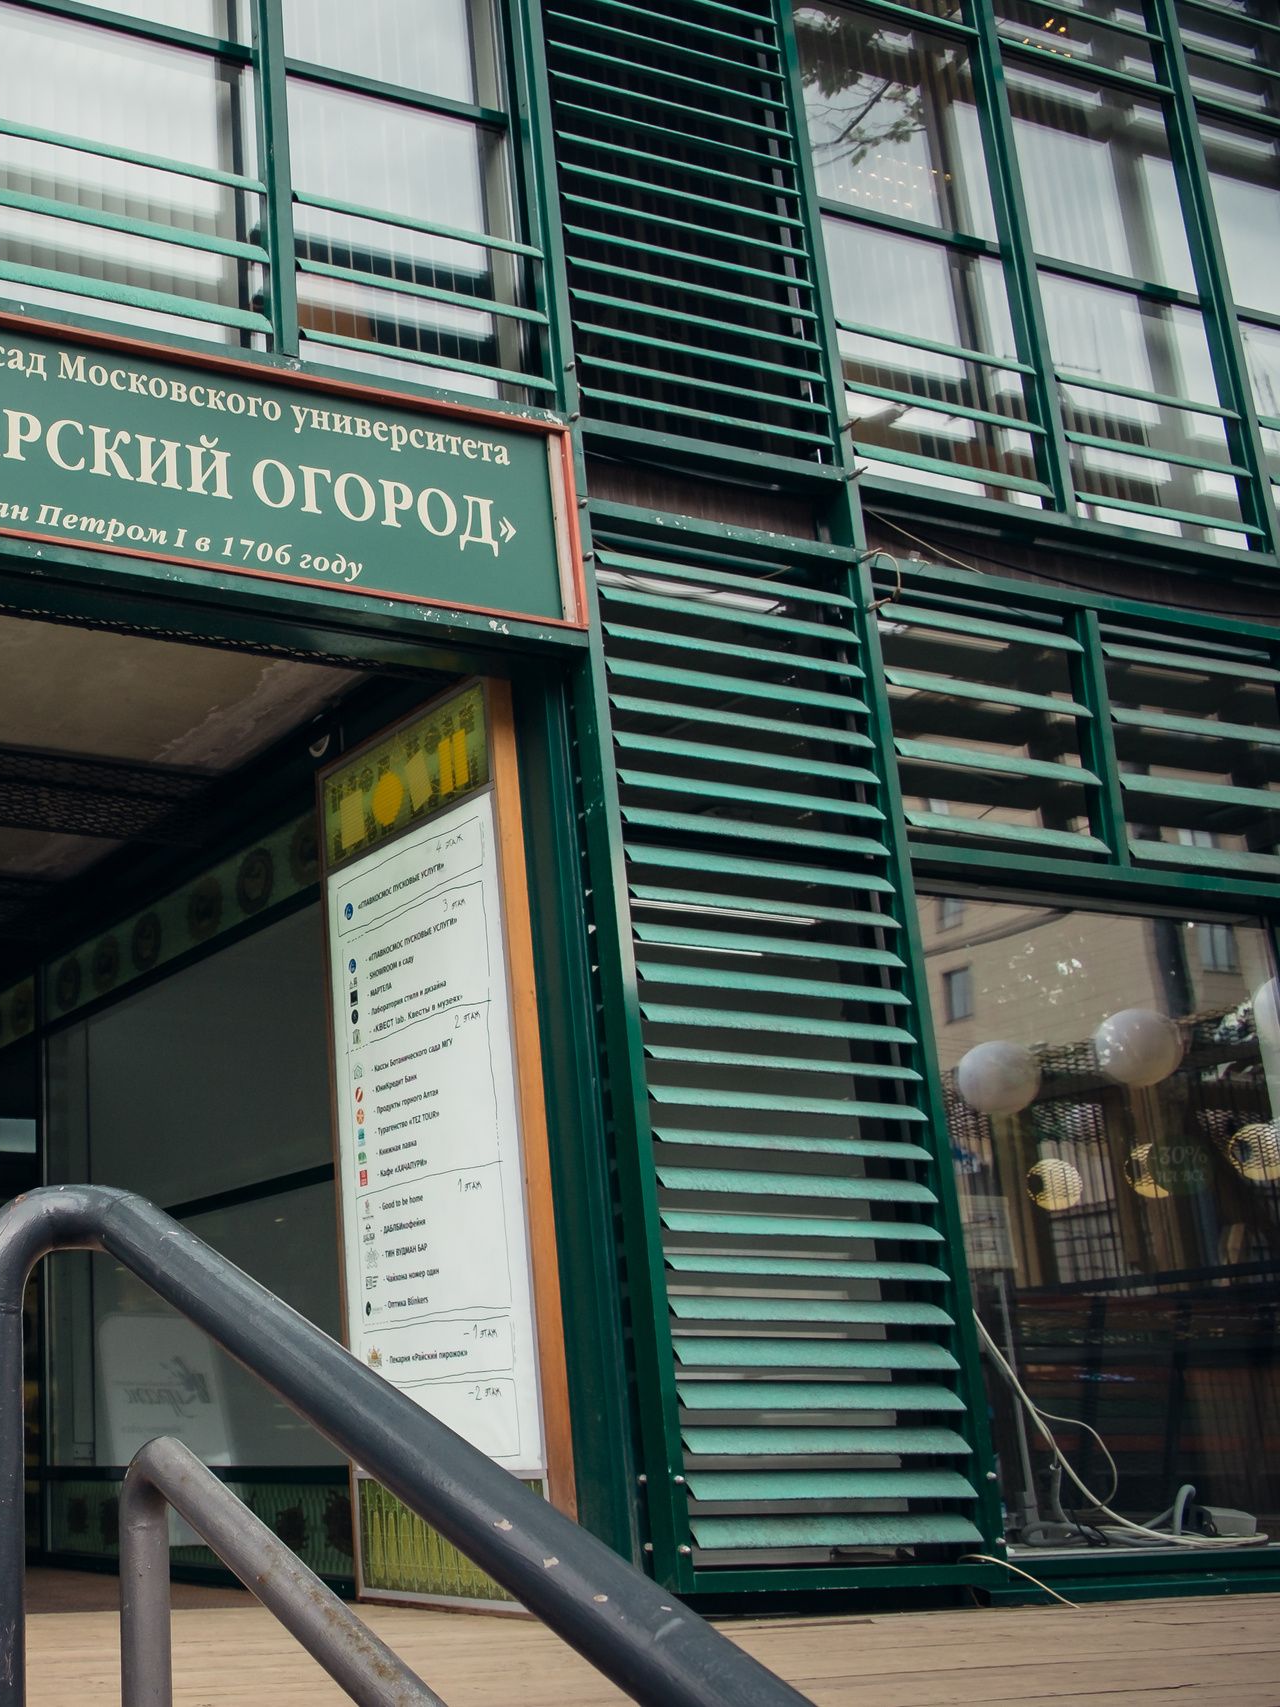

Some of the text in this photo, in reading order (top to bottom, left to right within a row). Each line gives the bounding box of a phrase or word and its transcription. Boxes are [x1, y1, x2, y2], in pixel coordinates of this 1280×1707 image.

[58, 351, 283, 424] Московского
[292, 401, 512, 468] университета
[37, 503, 169, 551] Петром
[194, 529, 214, 554] в
[223, 533, 293, 570] 1706
[298, 550, 364, 584] году
[253, 458, 517, 558] ОГОРОД»
[390, 1048, 427, 1067] Ботанического
[382, 1201, 395, 1210] Good
[409, 1194, 423, 1204] home
